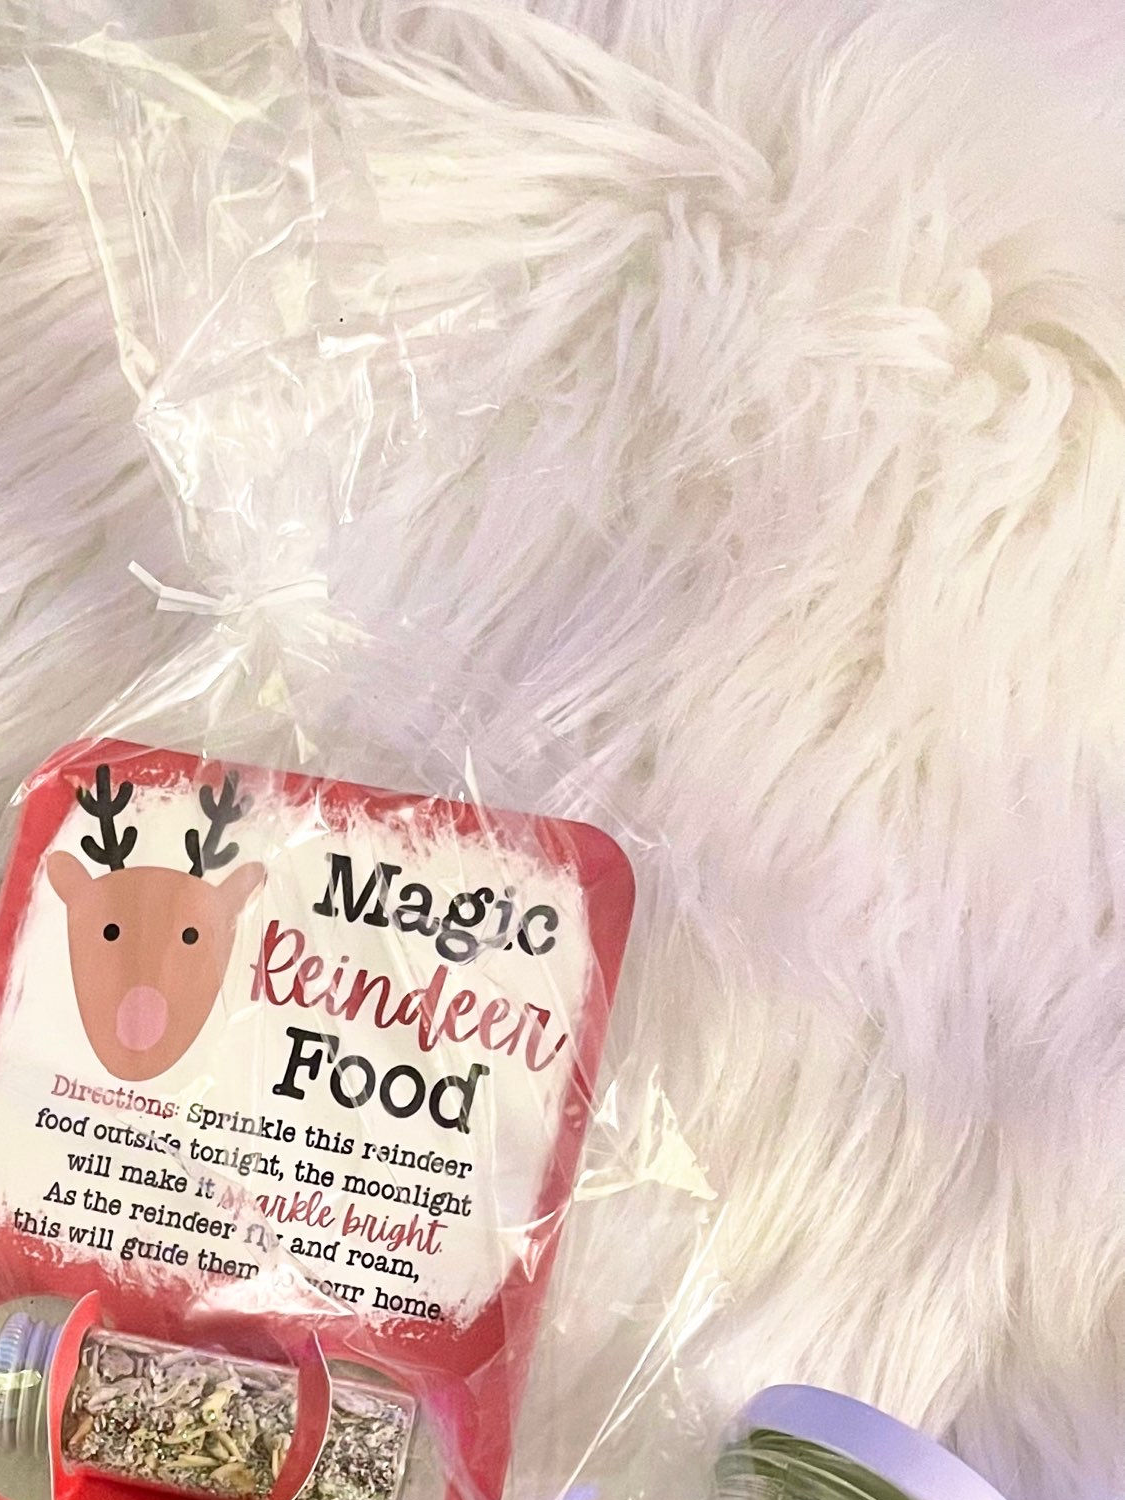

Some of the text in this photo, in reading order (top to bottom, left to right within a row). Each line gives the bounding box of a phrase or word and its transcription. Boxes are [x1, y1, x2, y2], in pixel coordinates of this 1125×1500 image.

[312, 852, 559, 966] Magic
[250, 920, 568, 1072] Reindeer
[50, 1073, 473, 1179] Directions: Sprinkle this reindeer
[272, 1026, 490, 1134] Food
[35, 1107, 473, 1217] food outside tonight, the moonlight
[66, 1153, 112, 1178] will
[118, 1164, 188, 1193] make
[194, 1175, 216, 1199] it
[341, 1202, 449, 1256] bright.
[13, 1207, 62, 1239] this
[68, 1225, 115, 1252] will
[120, 1237, 189, 1267] guide
[197, 1248, 260, 1281] them
[371, 1286, 445, 1323] home.
[43, 1181, 77, 1206] As
[83, 1187, 122, 1216] the
[128, 1203, 237, 1240] reindeer
[290, 1236, 341, 1263] and
[346, 1248, 420, 1284] roam,
